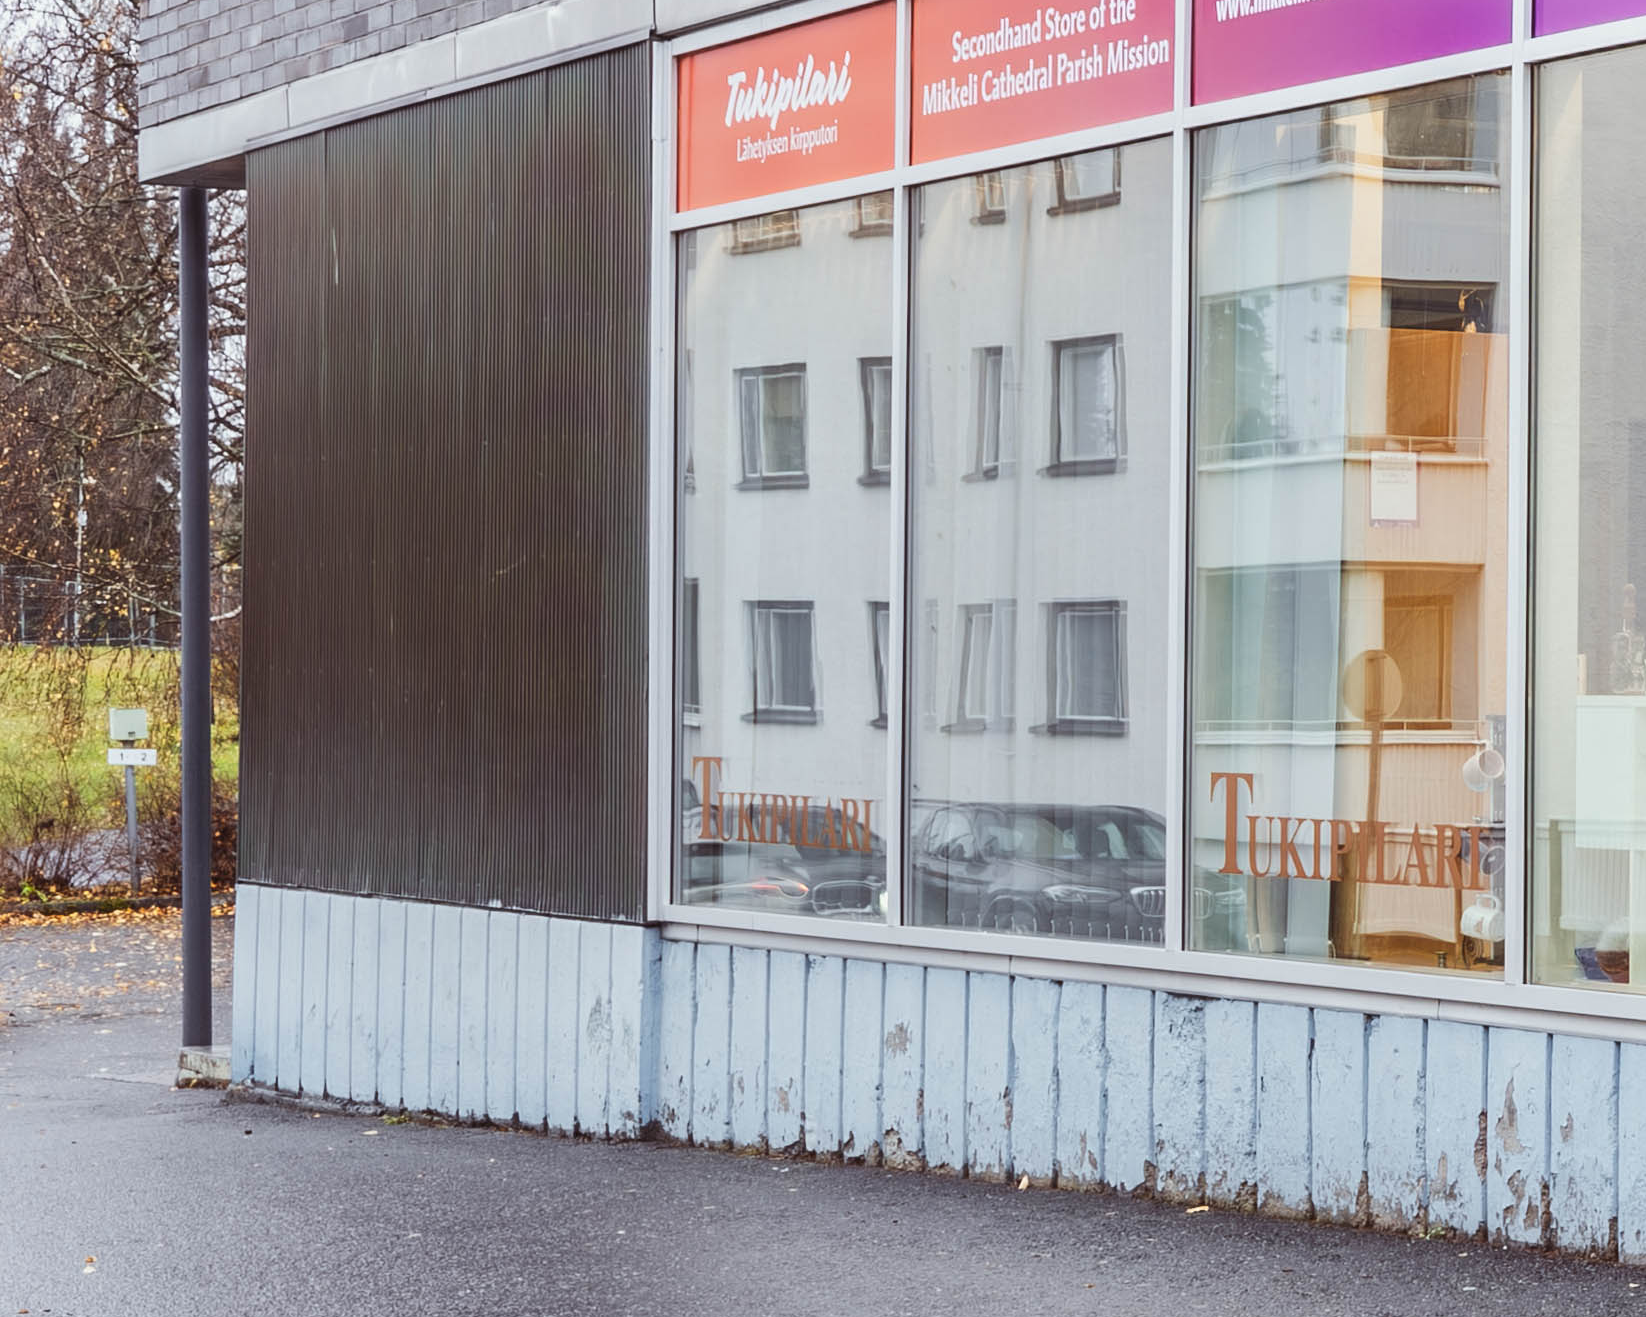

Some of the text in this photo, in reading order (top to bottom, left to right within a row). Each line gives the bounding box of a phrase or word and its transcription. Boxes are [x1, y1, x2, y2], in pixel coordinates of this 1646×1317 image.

[923, 35, 1169, 115] Mikkeli Cathedral Parish Mission
[952, 10, 1041, 62] Secondhand
[1045, 11, 1086, 40] Store
[725, 51, 851, 127] Tukipilari
[737, 121, 837, 163] Lähetyksen kirpputori
[692, 756, 873, 853] TUKIPILARI
[1210, 772, 1489, 890] TUKIPILARI
